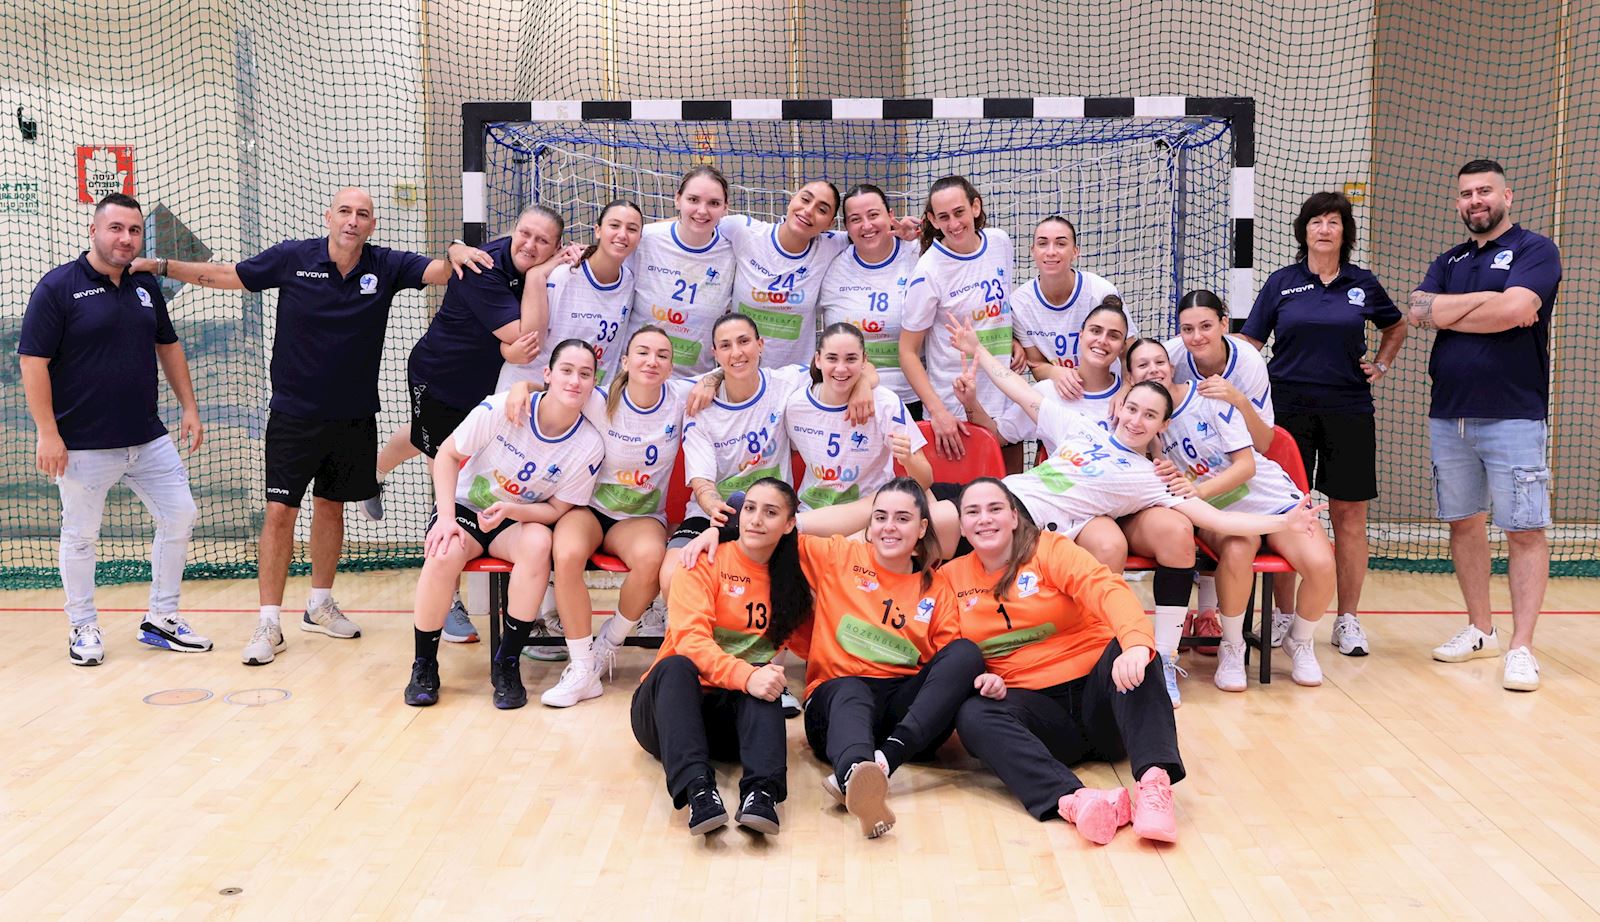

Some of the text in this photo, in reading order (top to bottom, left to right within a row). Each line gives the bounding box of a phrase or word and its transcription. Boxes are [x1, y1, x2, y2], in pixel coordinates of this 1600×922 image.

[15, 183, 38, 191] דלת
[296, 271, 329, 279] GIVOVA
[648, 265, 681, 276] GIVOVA
[671, 278, 698, 304] 21
[768, 273, 795, 291] 24
[950, 282, 980, 298] GIVOVA
[981, 279, 1004, 302] 23
[1281, 283, 1314, 296] GIVOVA
[73, 287, 106, 299] GIVOVA
[868, 292, 889, 312] 18
[597, 320, 619, 343] 33
[1055, 332, 1080, 357] 97
[608, 429, 642, 443] GIVOVA
[714, 433, 747, 448] GIVOVA
[747, 427, 769, 454] 81
[794, 425, 824, 436] GIVOVA
[826, 433, 841, 457] 5
[1083, 443, 1111, 461] 14
[1182, 437, 1198, 459] 6
[644, 444, 659, 467] 9
[517, 461, 537, 482] 8
[745, 601, 768, 630] 13
[996, 603, 1012, 630] 1
[845, 623, 915, 656] ROZENBLATT
